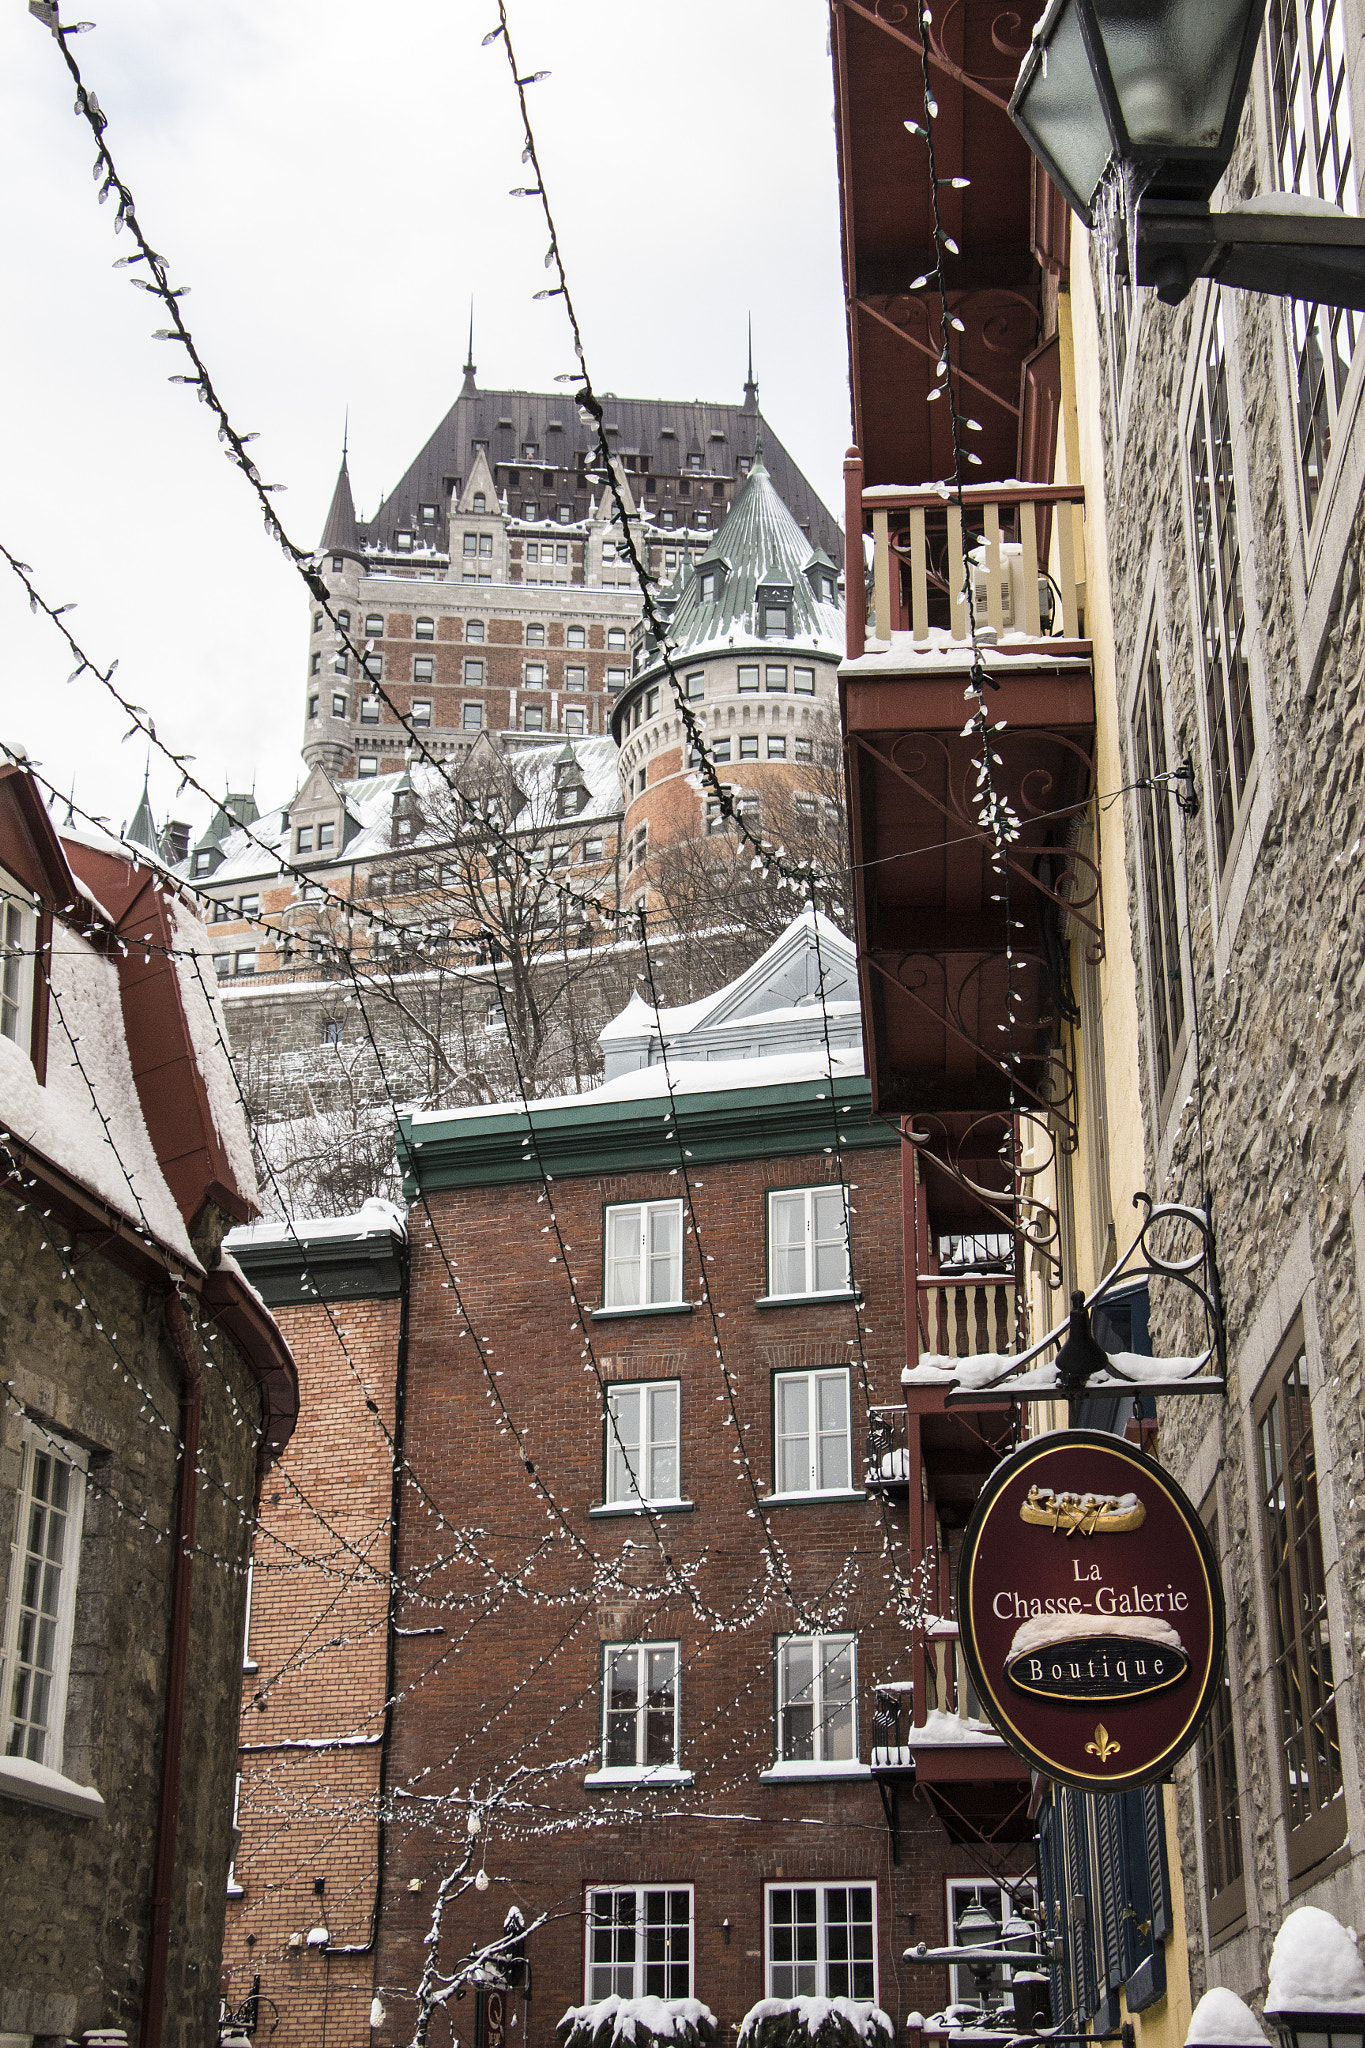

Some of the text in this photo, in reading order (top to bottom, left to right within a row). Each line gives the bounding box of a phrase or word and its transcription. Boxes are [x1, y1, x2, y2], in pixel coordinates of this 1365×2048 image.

[1072, 1559, 1103, 1582] La
[992, 1583, 1189, 1620] Chasse-Galerie
[1028, 1654, 1165, 1683] Boutique
